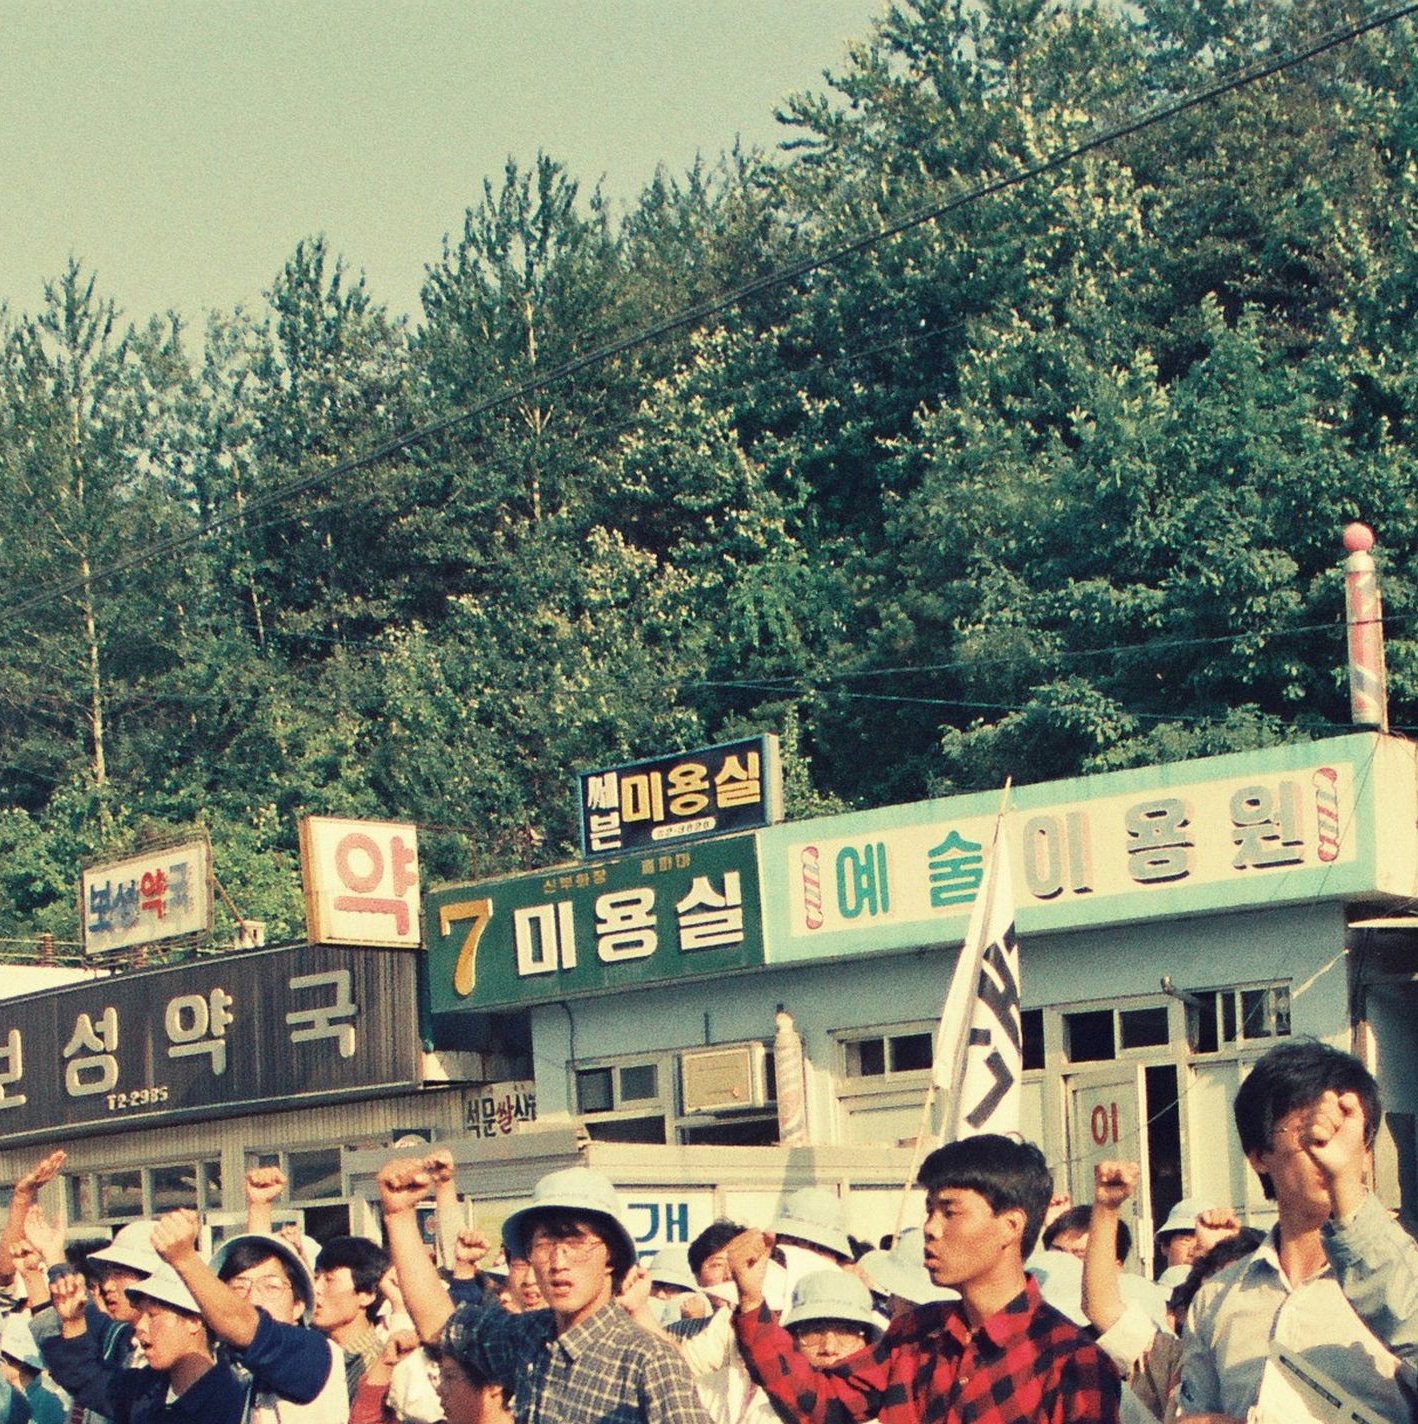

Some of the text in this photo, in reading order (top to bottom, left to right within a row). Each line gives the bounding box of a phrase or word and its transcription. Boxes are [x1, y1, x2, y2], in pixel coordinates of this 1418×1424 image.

[621, 752, 760, 822] 미용실
[88, 862, 190, 933] 보성약국
[334, 832, 417, 935] 약
[836, 779, 1305, 918] 예술 이용원
[439, 871, 744, 997] 7 미용실
